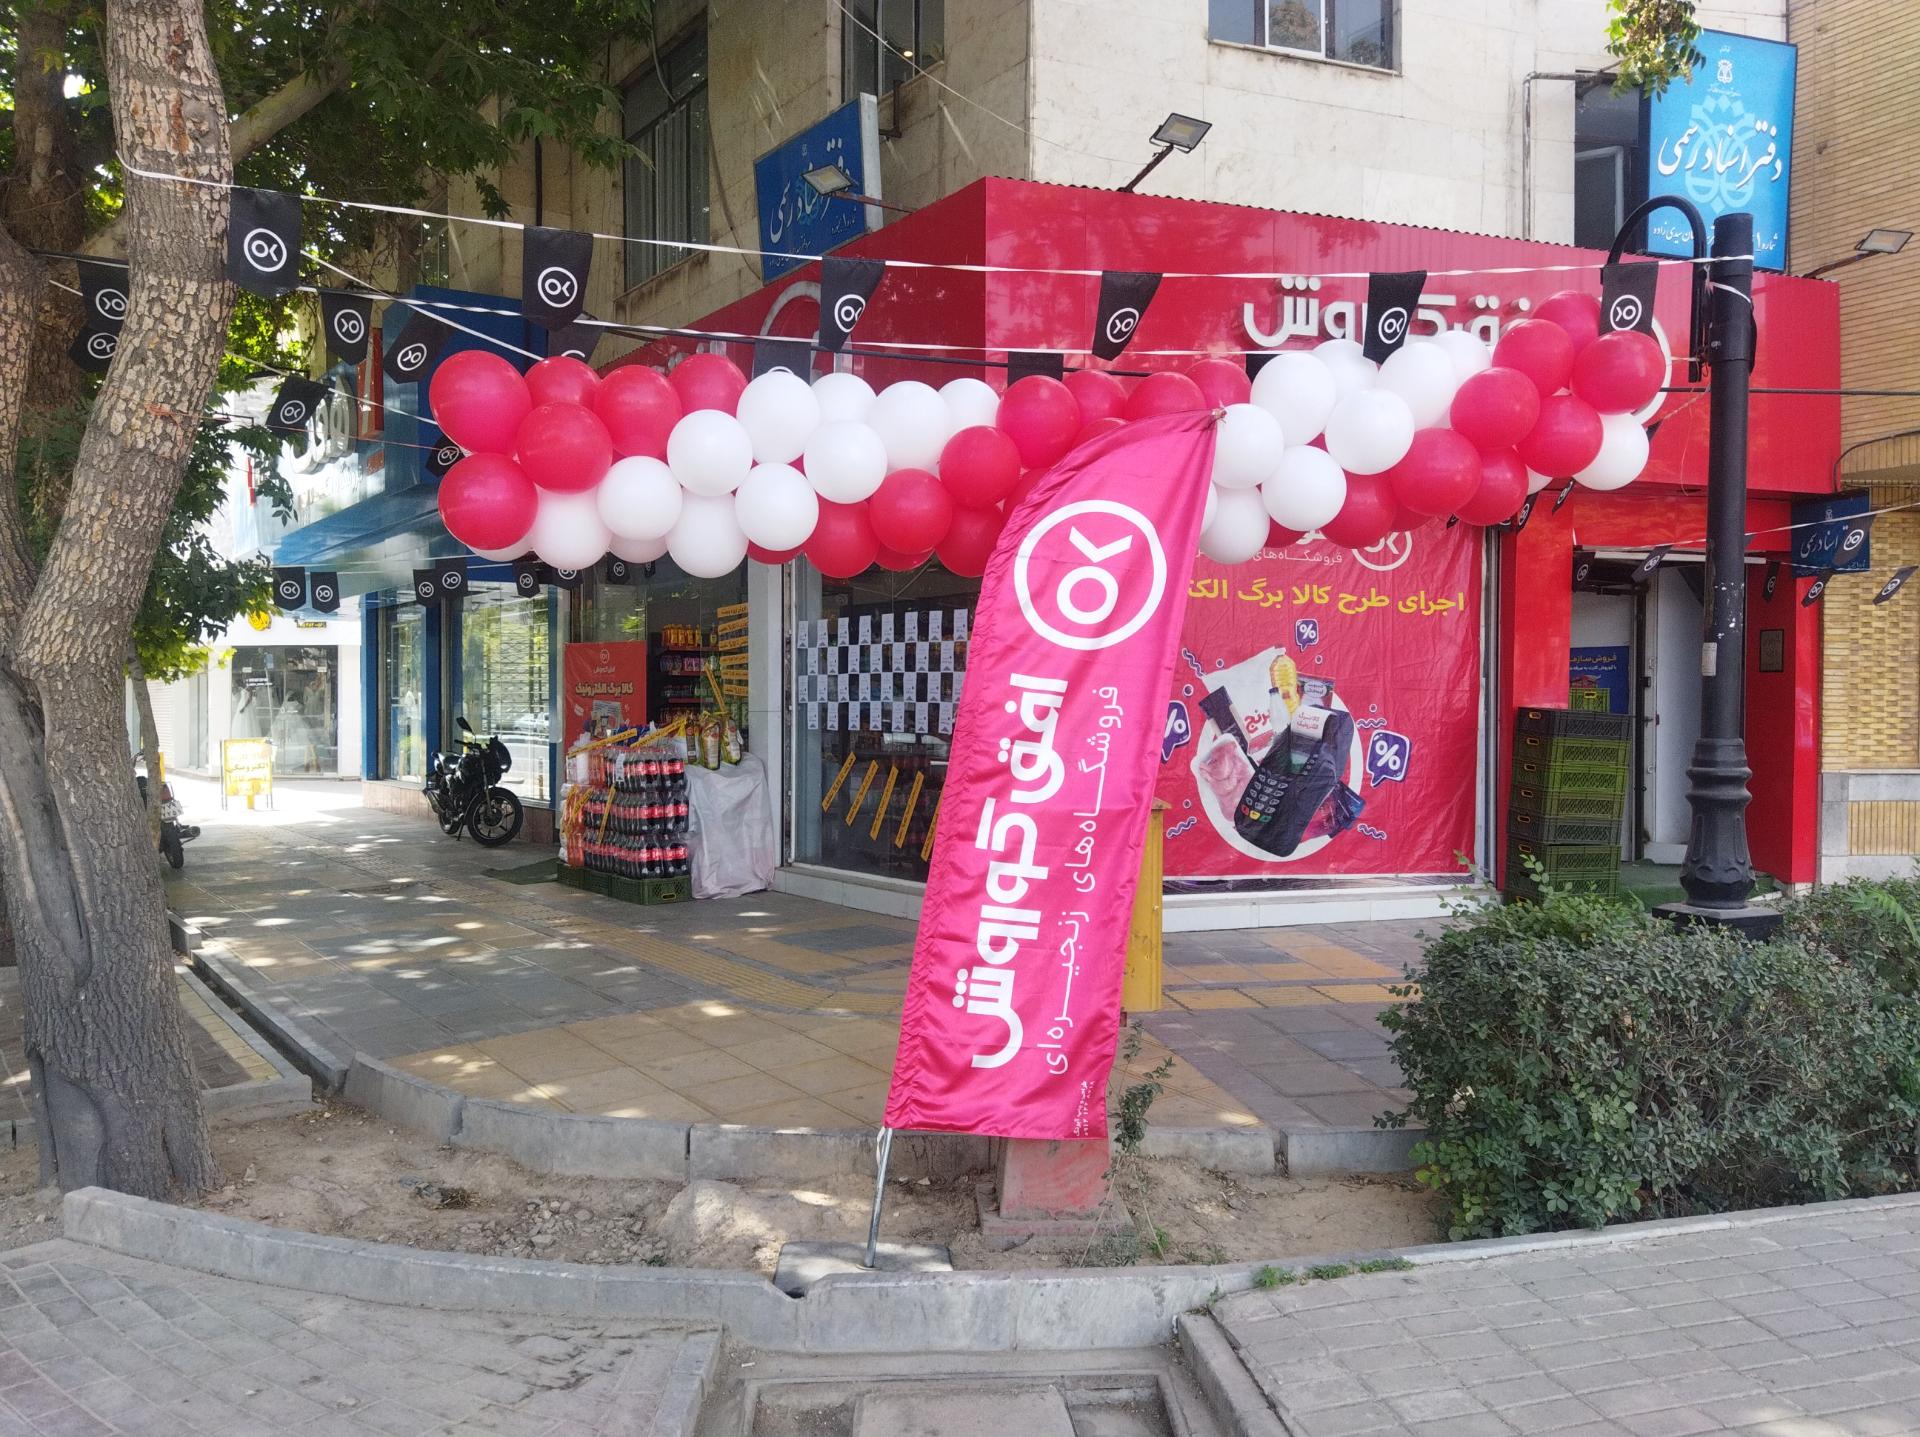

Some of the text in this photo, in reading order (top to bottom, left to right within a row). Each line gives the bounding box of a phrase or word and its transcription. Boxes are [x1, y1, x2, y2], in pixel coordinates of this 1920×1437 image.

[1657, 120, 1782, 190] دفتر اسناد رسمی
[1237, 577, 1285, 609] برگ
[1291, 583, 1332, 605] کالا
[1338, 587, 1390, 615] طرح
[1398, 590, 1465, 616] اجرای
[953, 672, 1069, 1069] افق کوروش
